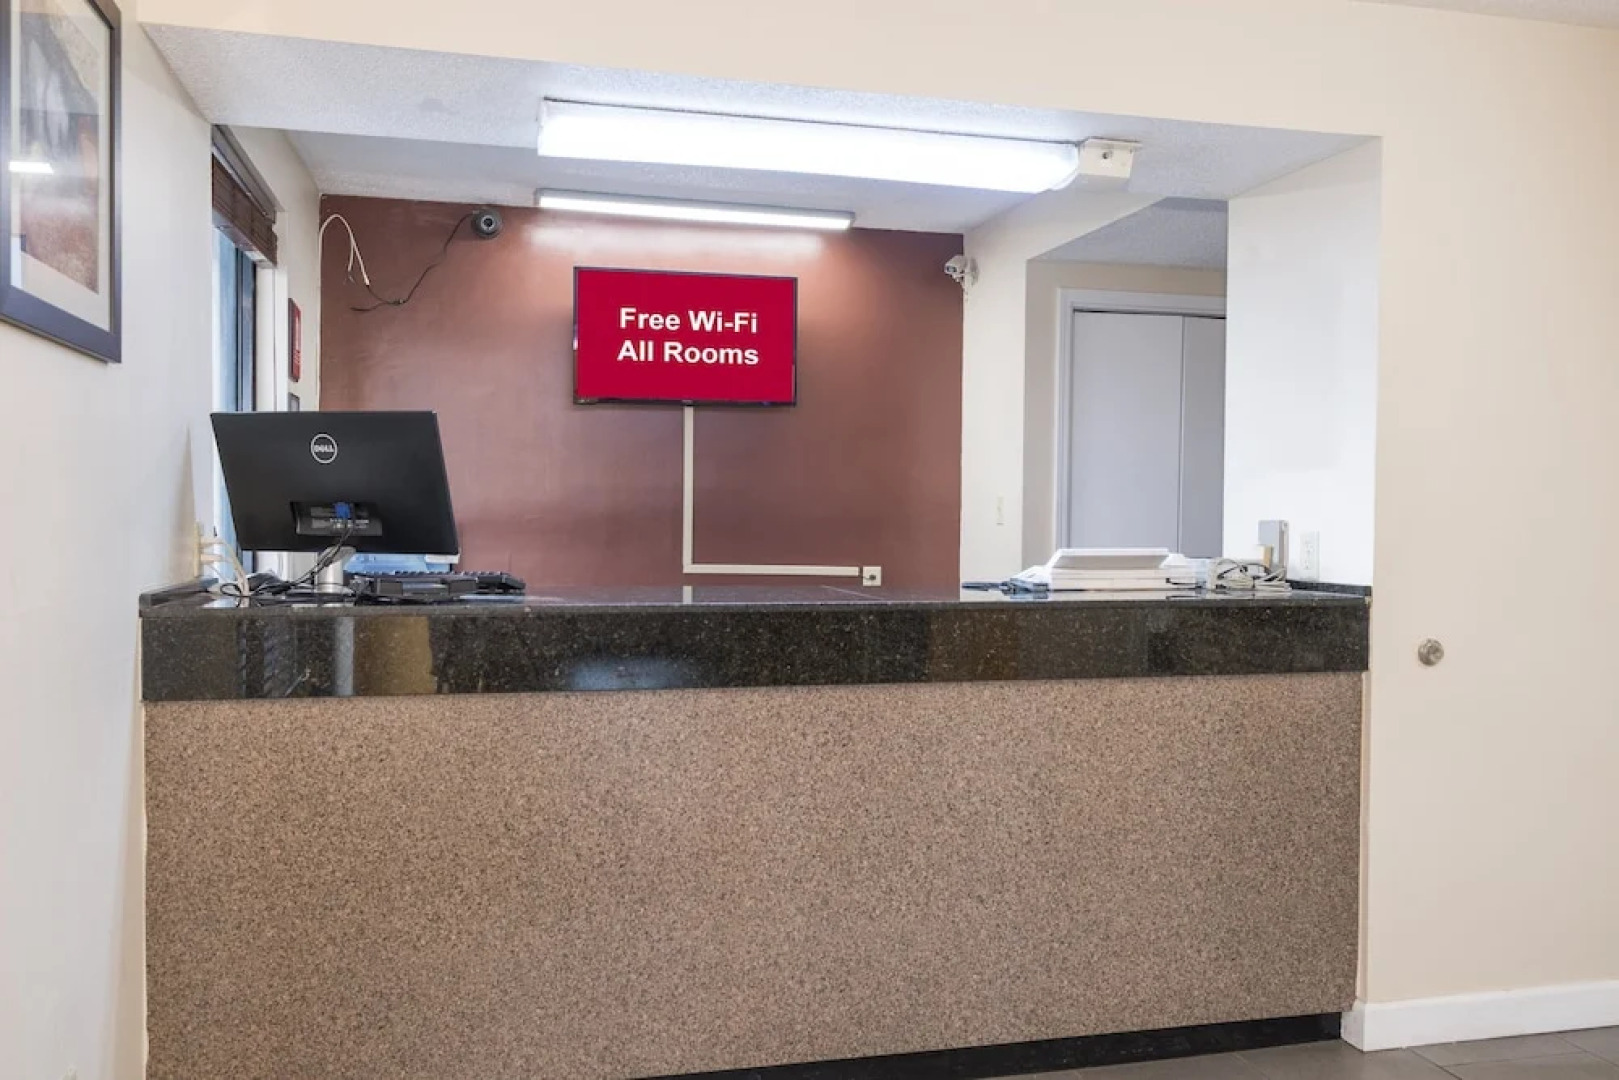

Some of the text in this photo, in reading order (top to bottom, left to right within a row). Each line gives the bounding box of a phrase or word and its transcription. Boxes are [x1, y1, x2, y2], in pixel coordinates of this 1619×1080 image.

[618, 307, 758, 333] Free Wi-Fi
[616, 339, 760, 365] All Rooms
[313, 444, 335, 453] DELL
